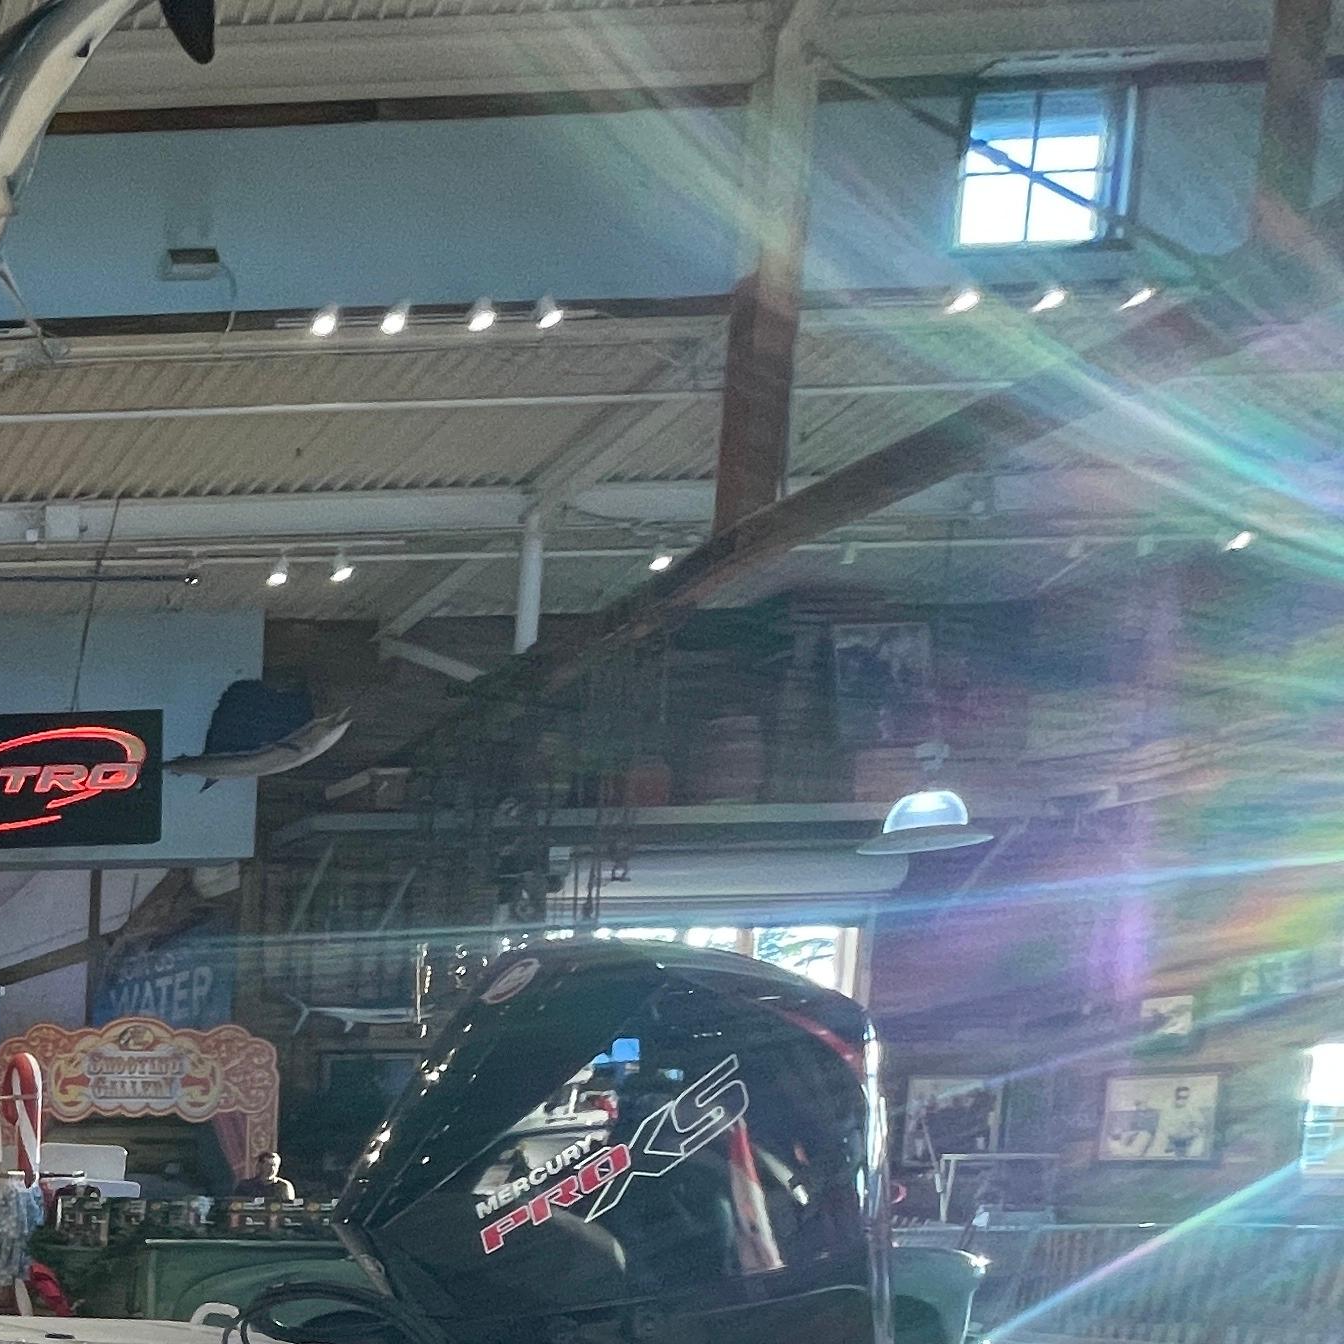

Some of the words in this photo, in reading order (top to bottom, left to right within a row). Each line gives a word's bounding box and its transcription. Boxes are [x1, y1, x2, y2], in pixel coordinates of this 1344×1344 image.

[110, 966, 213, 1019] WATER
[475, 1134, 595, 1219] MERCURY
[480, 1144, 631, 1254] PRO
[584, 1053, 749, 1223] XS
